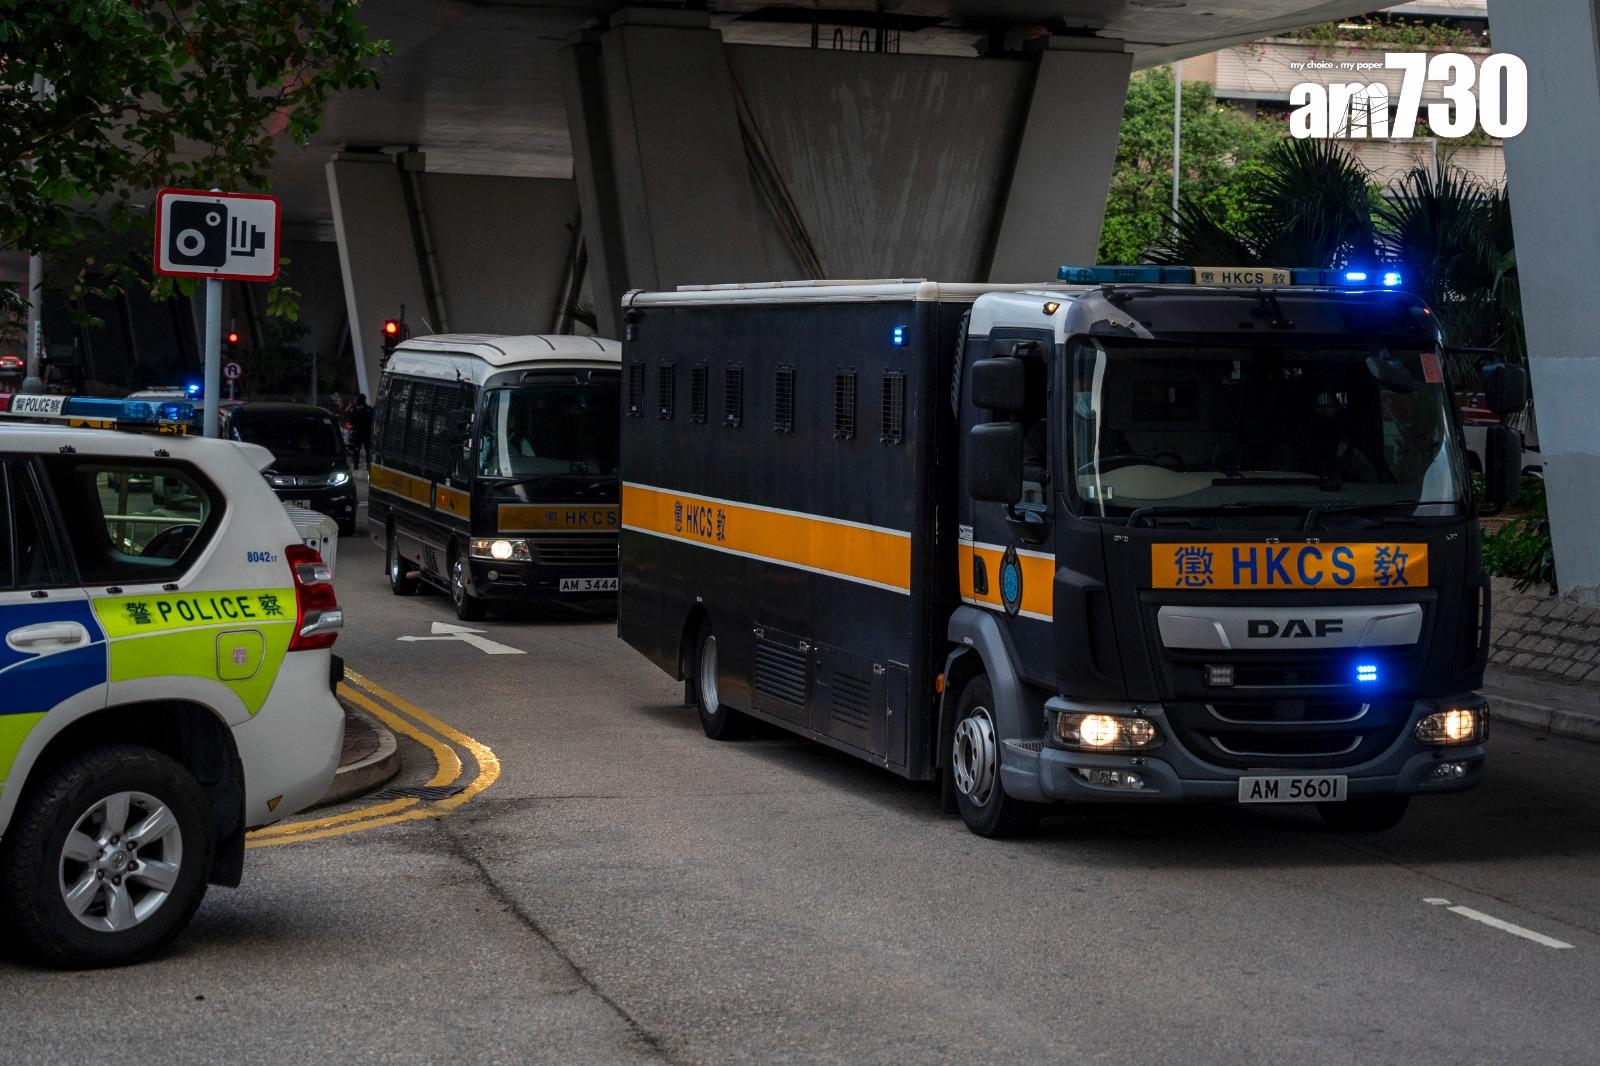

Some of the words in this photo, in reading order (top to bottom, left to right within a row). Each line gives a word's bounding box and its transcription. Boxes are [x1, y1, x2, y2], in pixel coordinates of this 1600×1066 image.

[1222, 272, 1264, 284] HKCS
[25, 397, 51, 413] POLICE
[565, 511, 617, 526] HKCS
[686, 503, 713, 538] HKCS
[1174, 545, 1214, 587] 懲
[1232, 546, 1356, 586] HKCS
[562, 580, 579, 590] AM
[584, 580, 617, 590] 3444
[125, 601, 152, 625] 警
[156, 596, 256, 623] POLICE
[257, 594, 284, 617] 察
[1247, 619, 1343, 638] DAF
[1250, 779, 1279, 799] AM
[1289, 779, 1338, 798] 5601
